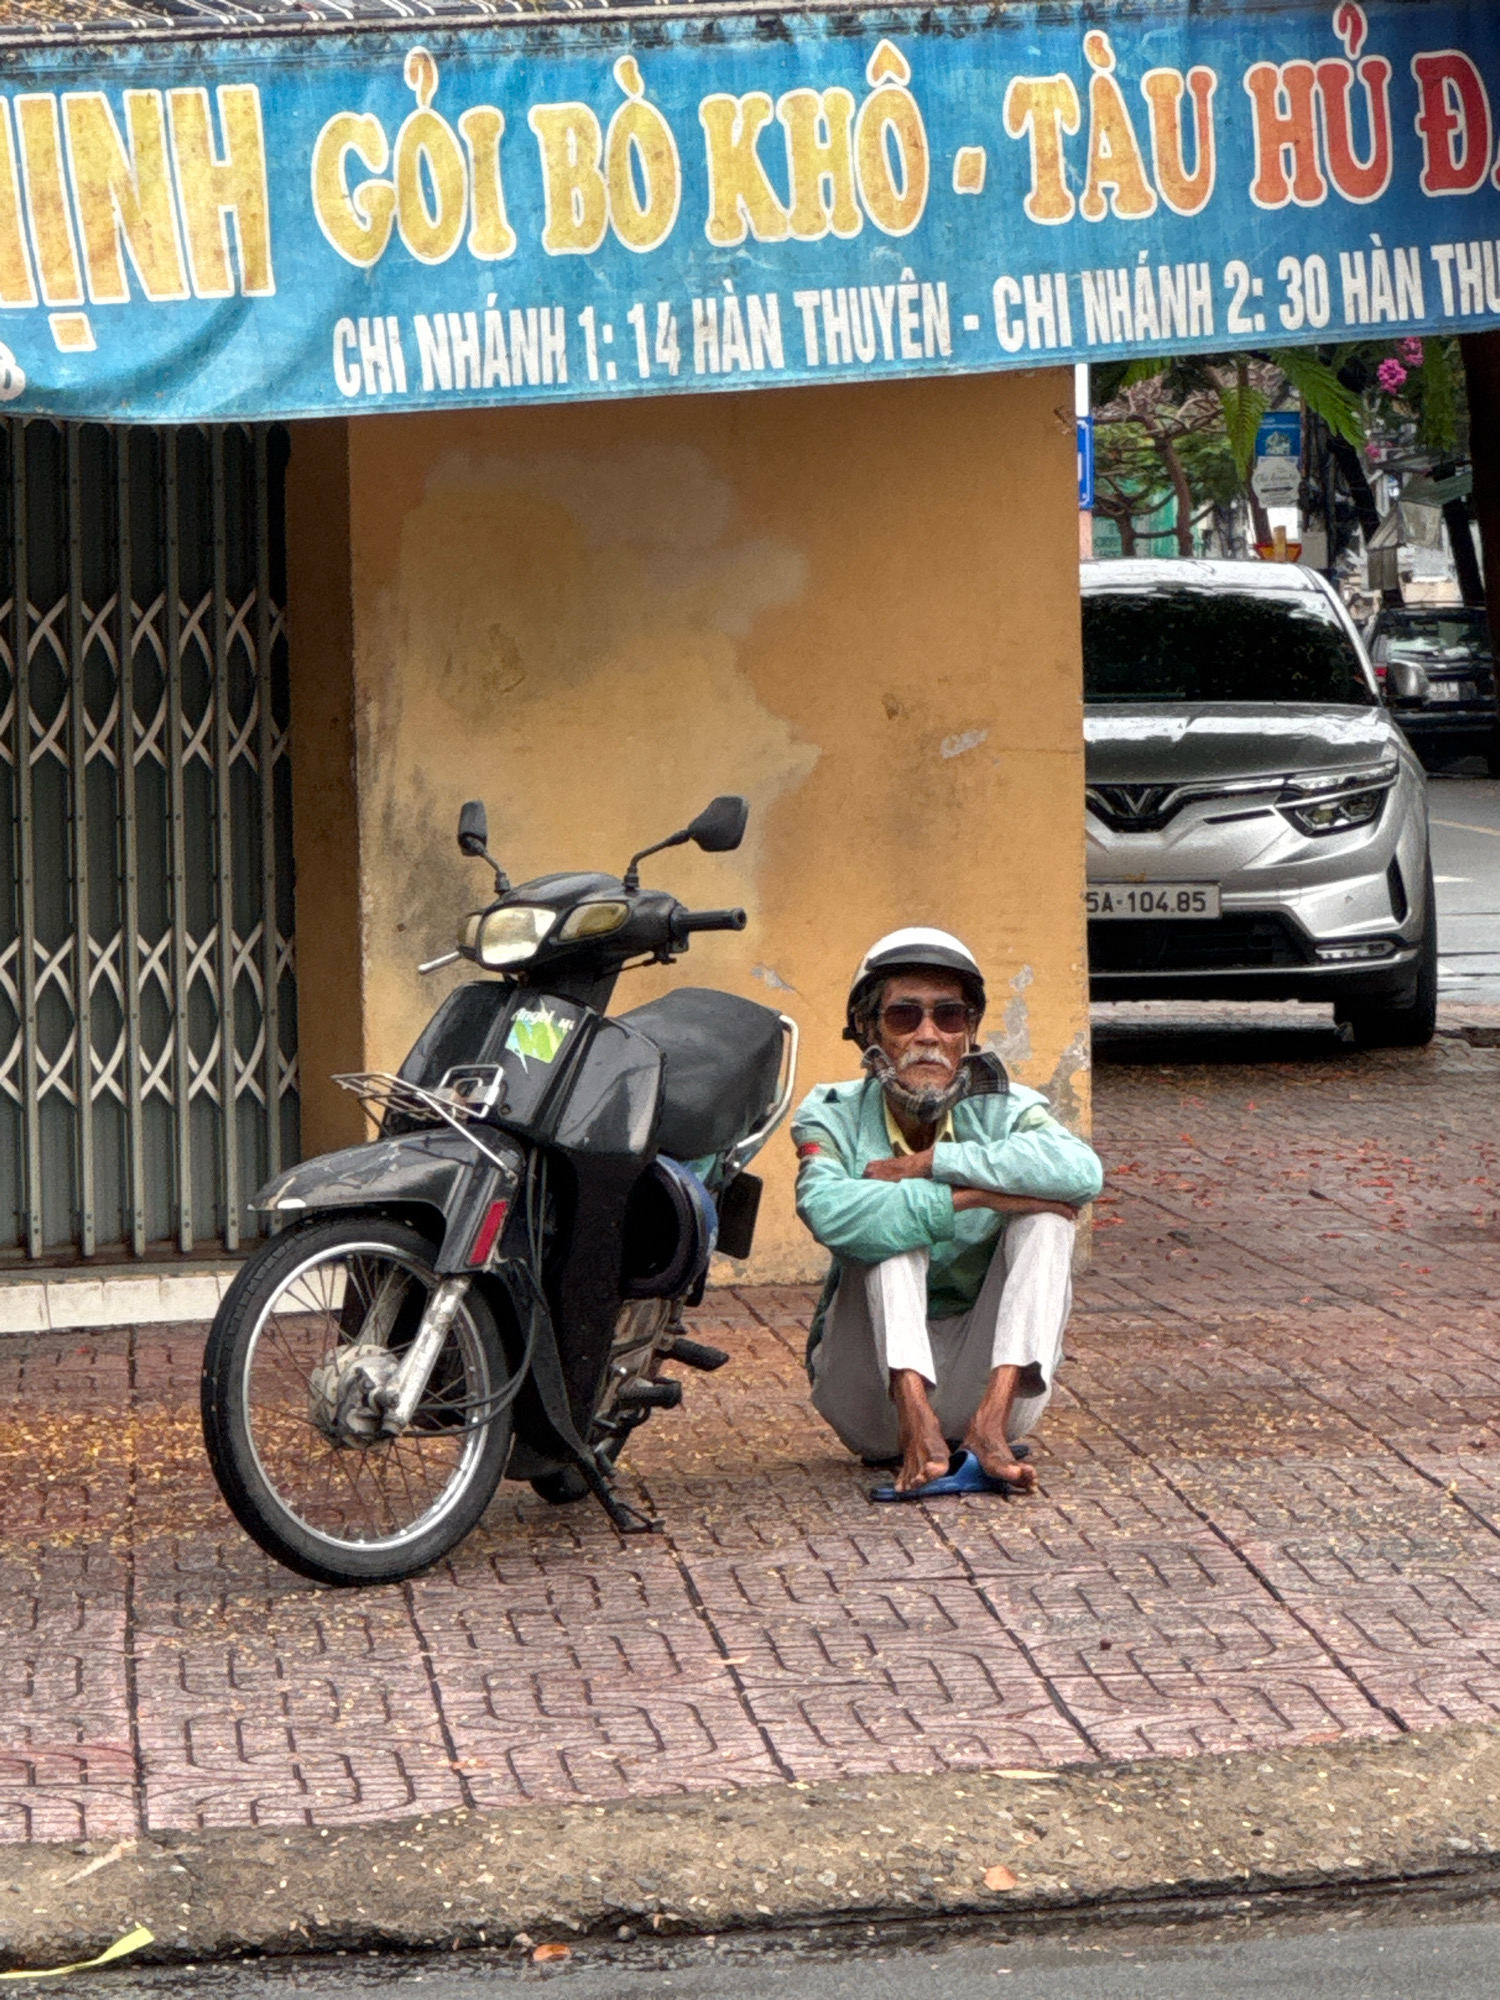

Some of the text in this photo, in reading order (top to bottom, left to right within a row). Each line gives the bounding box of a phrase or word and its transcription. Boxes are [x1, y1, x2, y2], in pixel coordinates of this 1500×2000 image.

[311, 46, 517, 267] GỎI
[528, 55, 682, 256] BÒ
[699, 39, 930, 248] KHÔ
[1003, 30, 1217, 225] TÀU
[1244, 1, 1392, 210] HỦ
[1411, 49, 1500, 198] Đ
[333, 317, 407, 398] CHI
[413, 292, 568, 392] NHÁNH
[578, 306, 617, 381] 1:
[627, 301, 679, 378] 14
[692, 278, 785, 374] HÀN
[794, 267, 952, 366] THUYÊN
[993, 273, 1072, 352] CHI
[1081, 250, 1214, 345] NHÁNH
[1224, 260, 1265, 334] 2:
[1278, 254, 1329, 330] 30
[1339, 233, 1425, 325] HÀN
